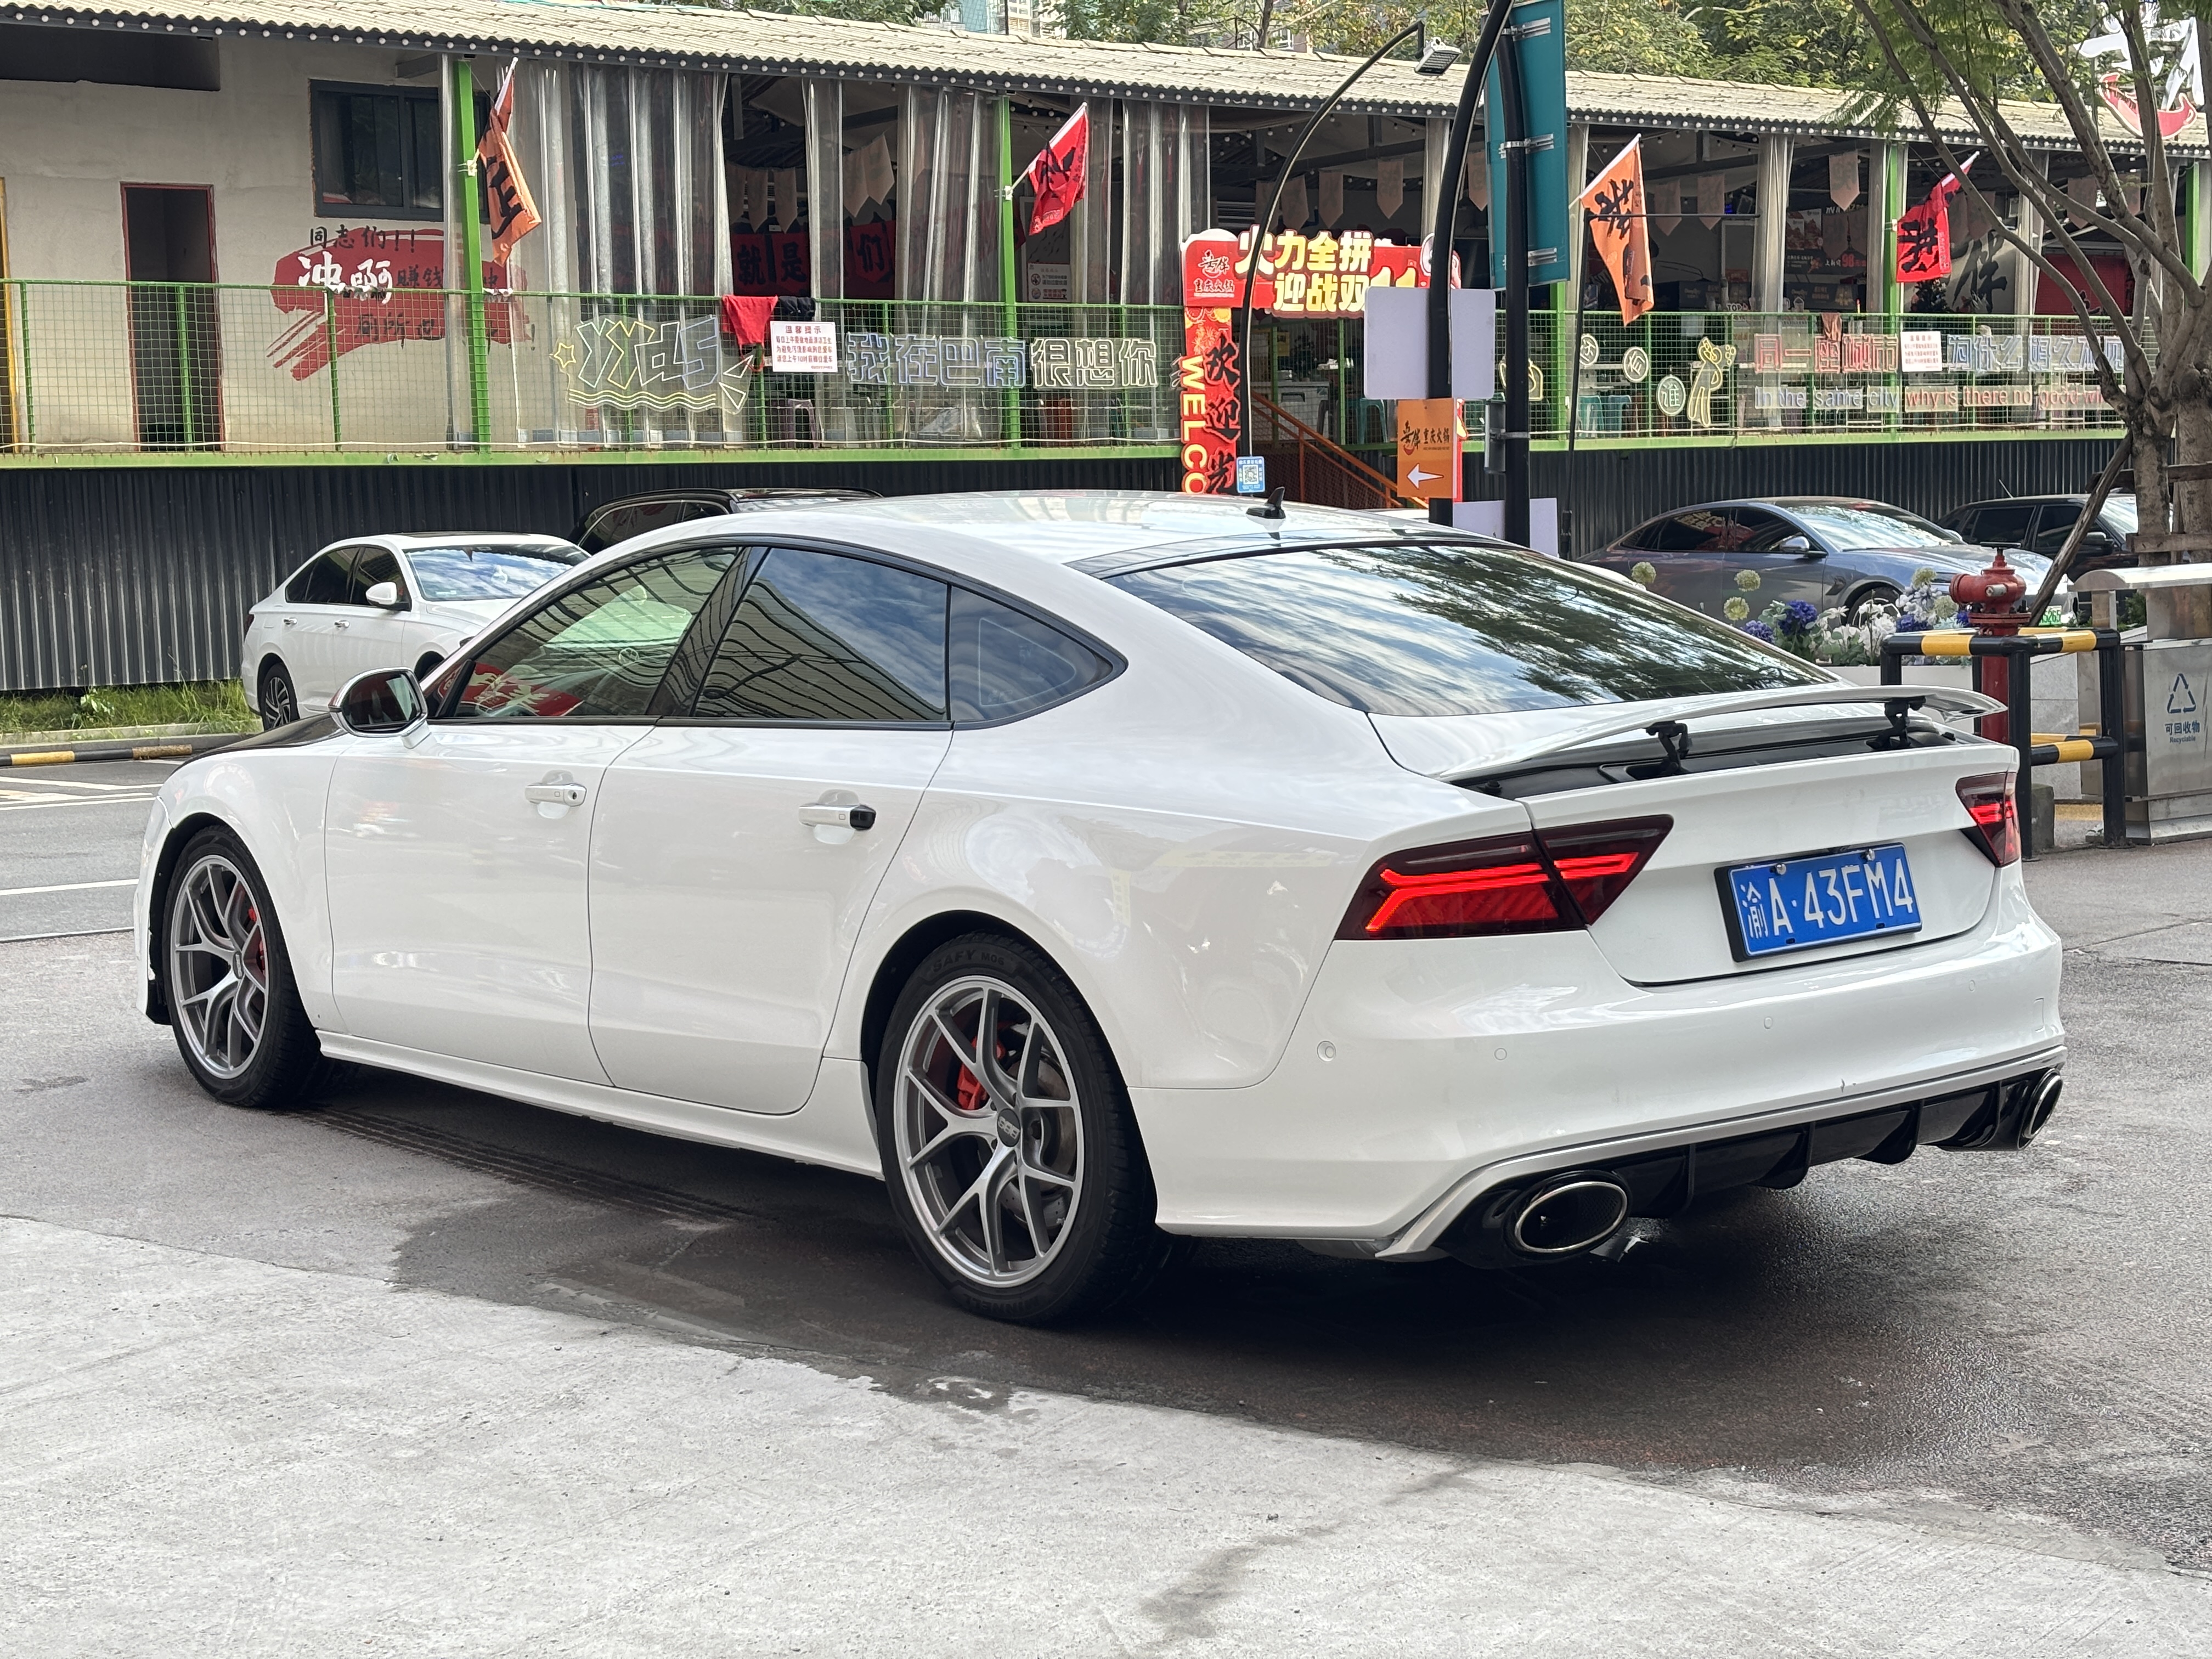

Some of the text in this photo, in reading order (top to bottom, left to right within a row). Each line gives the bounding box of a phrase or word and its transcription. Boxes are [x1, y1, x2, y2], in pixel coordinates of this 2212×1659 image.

[1234, 224, 1372, 274] 火力全拼
[847, 332, 1026, 387] 我在巴南
[1030, 337, 1158, 388] 很想你
[1754, 334, 1898, 373] 同一座城市
[1948, 336, 2023, 372] 为什么
[1814, 390, 1861, 408] same
[1869, 388, 1898, 411] city
[1906, 389, 1940, 411] why
[1965, 388, 2007, 405] there
[2013, 390, 2032, 405] no
[2039, 386, 2079, 408] good
[2165, 720, 2200, 736] 可回收物
[2170, 735, 2196, 744] Recyclable
